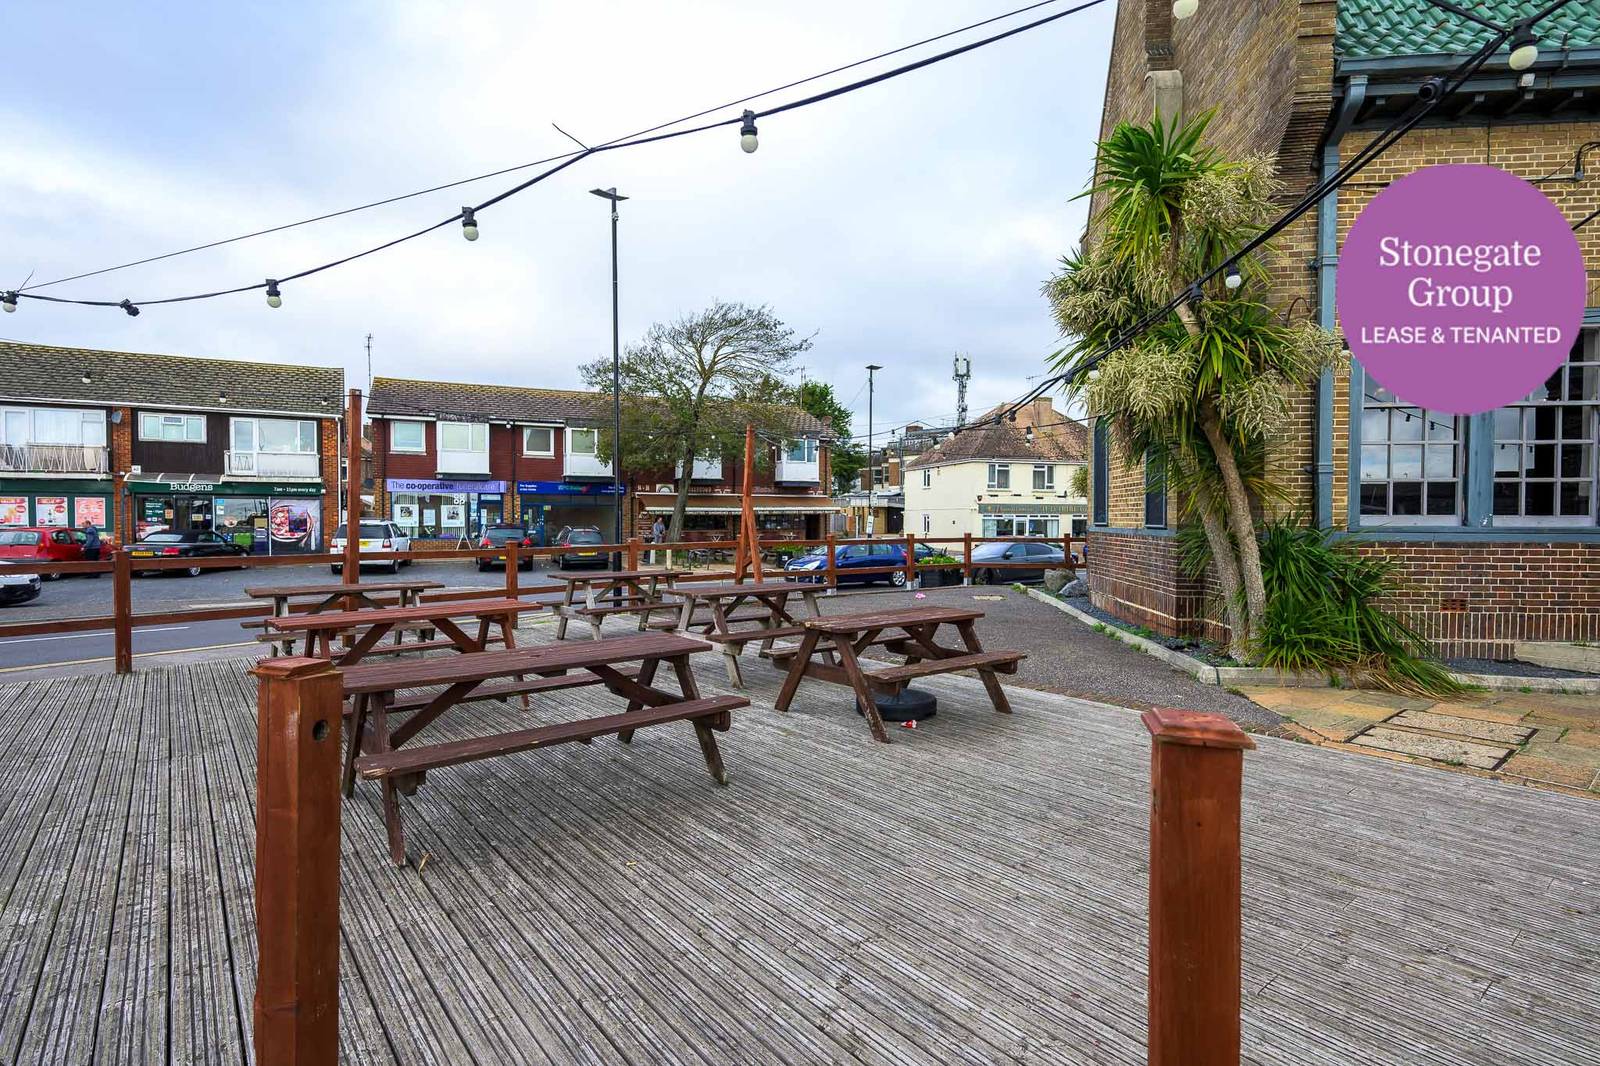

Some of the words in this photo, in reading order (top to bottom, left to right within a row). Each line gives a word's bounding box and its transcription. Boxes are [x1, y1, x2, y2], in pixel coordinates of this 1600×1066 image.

[170, 483, 213, 492] Budgens
[391, 481, 404, 489] The
[405, 482, 454, 491] co-operative
